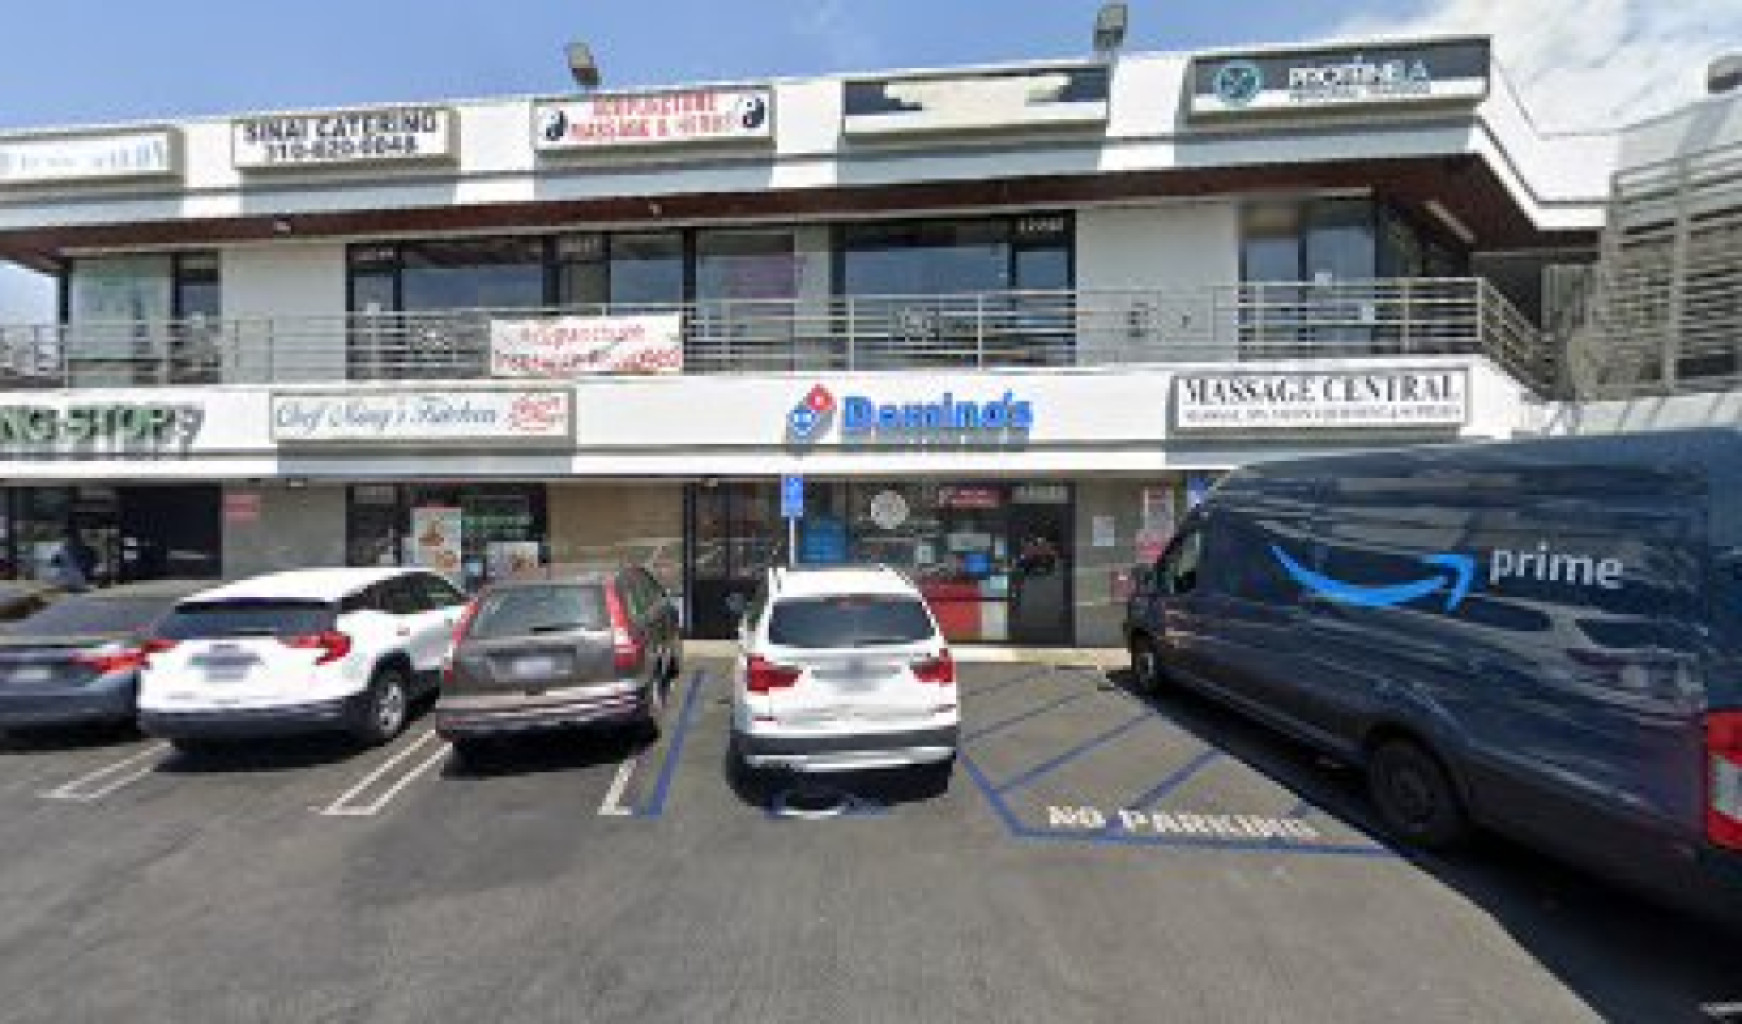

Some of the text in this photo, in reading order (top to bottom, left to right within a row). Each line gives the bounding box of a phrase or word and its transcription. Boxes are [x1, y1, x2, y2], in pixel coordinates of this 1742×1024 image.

[243, 109, 437, 142] SINAI CATERING
[1184, 374, 1461, 403] MASSAGE CENTRAL
[844, 389, 1034, 430] Domino's
[1490, 542, 1623, 589] prime
[1048, 805, 1320, 838] NO PARKING
